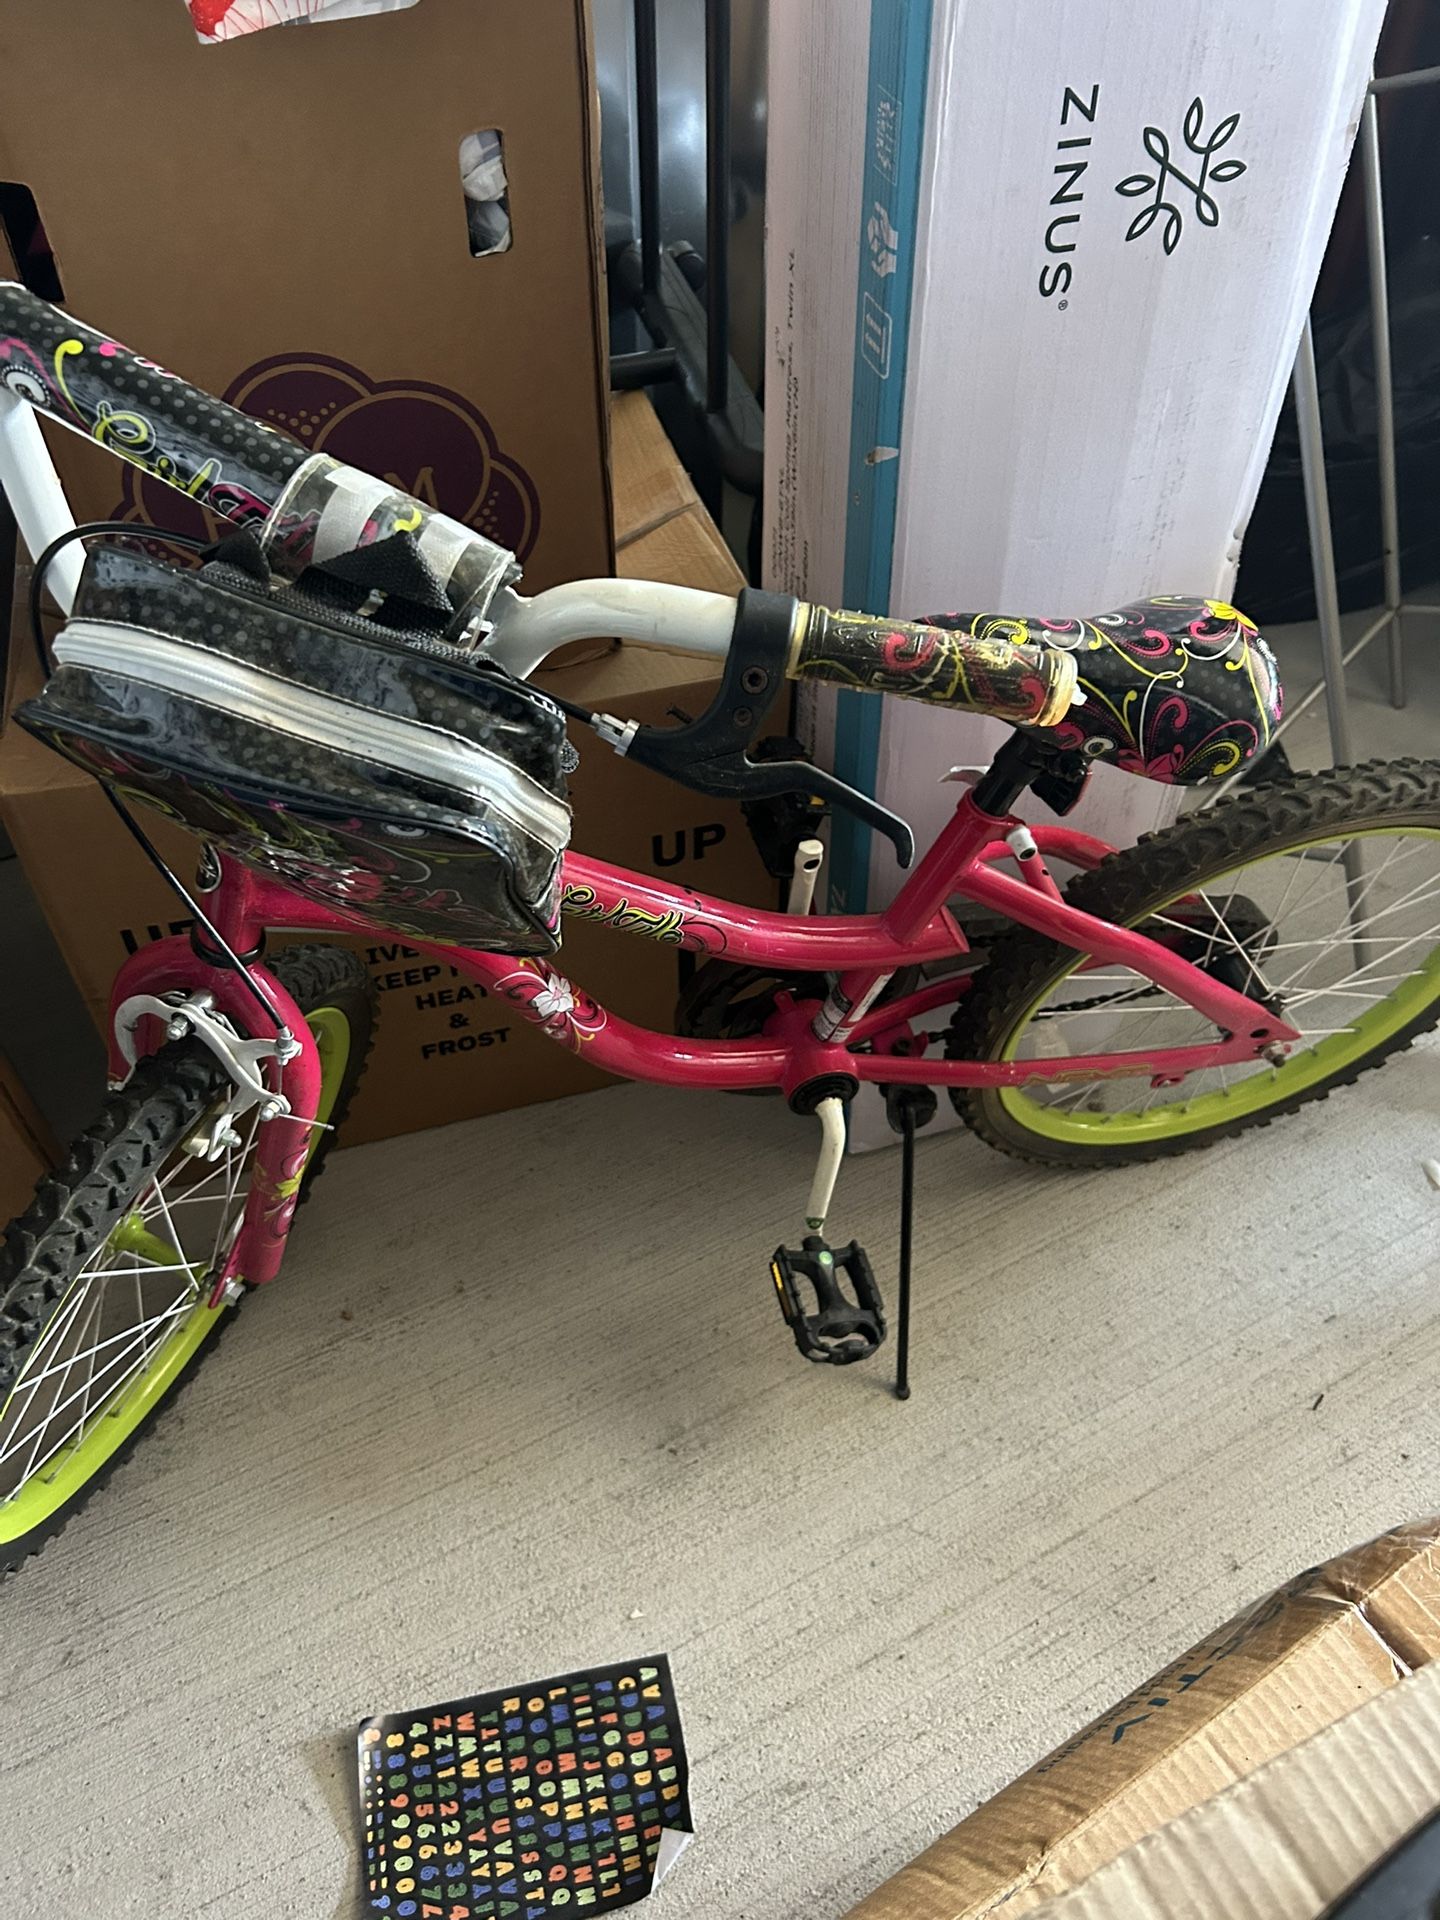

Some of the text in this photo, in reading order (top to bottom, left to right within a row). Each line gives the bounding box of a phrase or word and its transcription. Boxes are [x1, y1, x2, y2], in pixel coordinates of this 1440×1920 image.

[1039, 84, 1100, 298] ZINUS
[652, 823, 726, 867] UP
[449, 1012, 470, 1029] &
[421, 1027, 512, 1060] FROST
